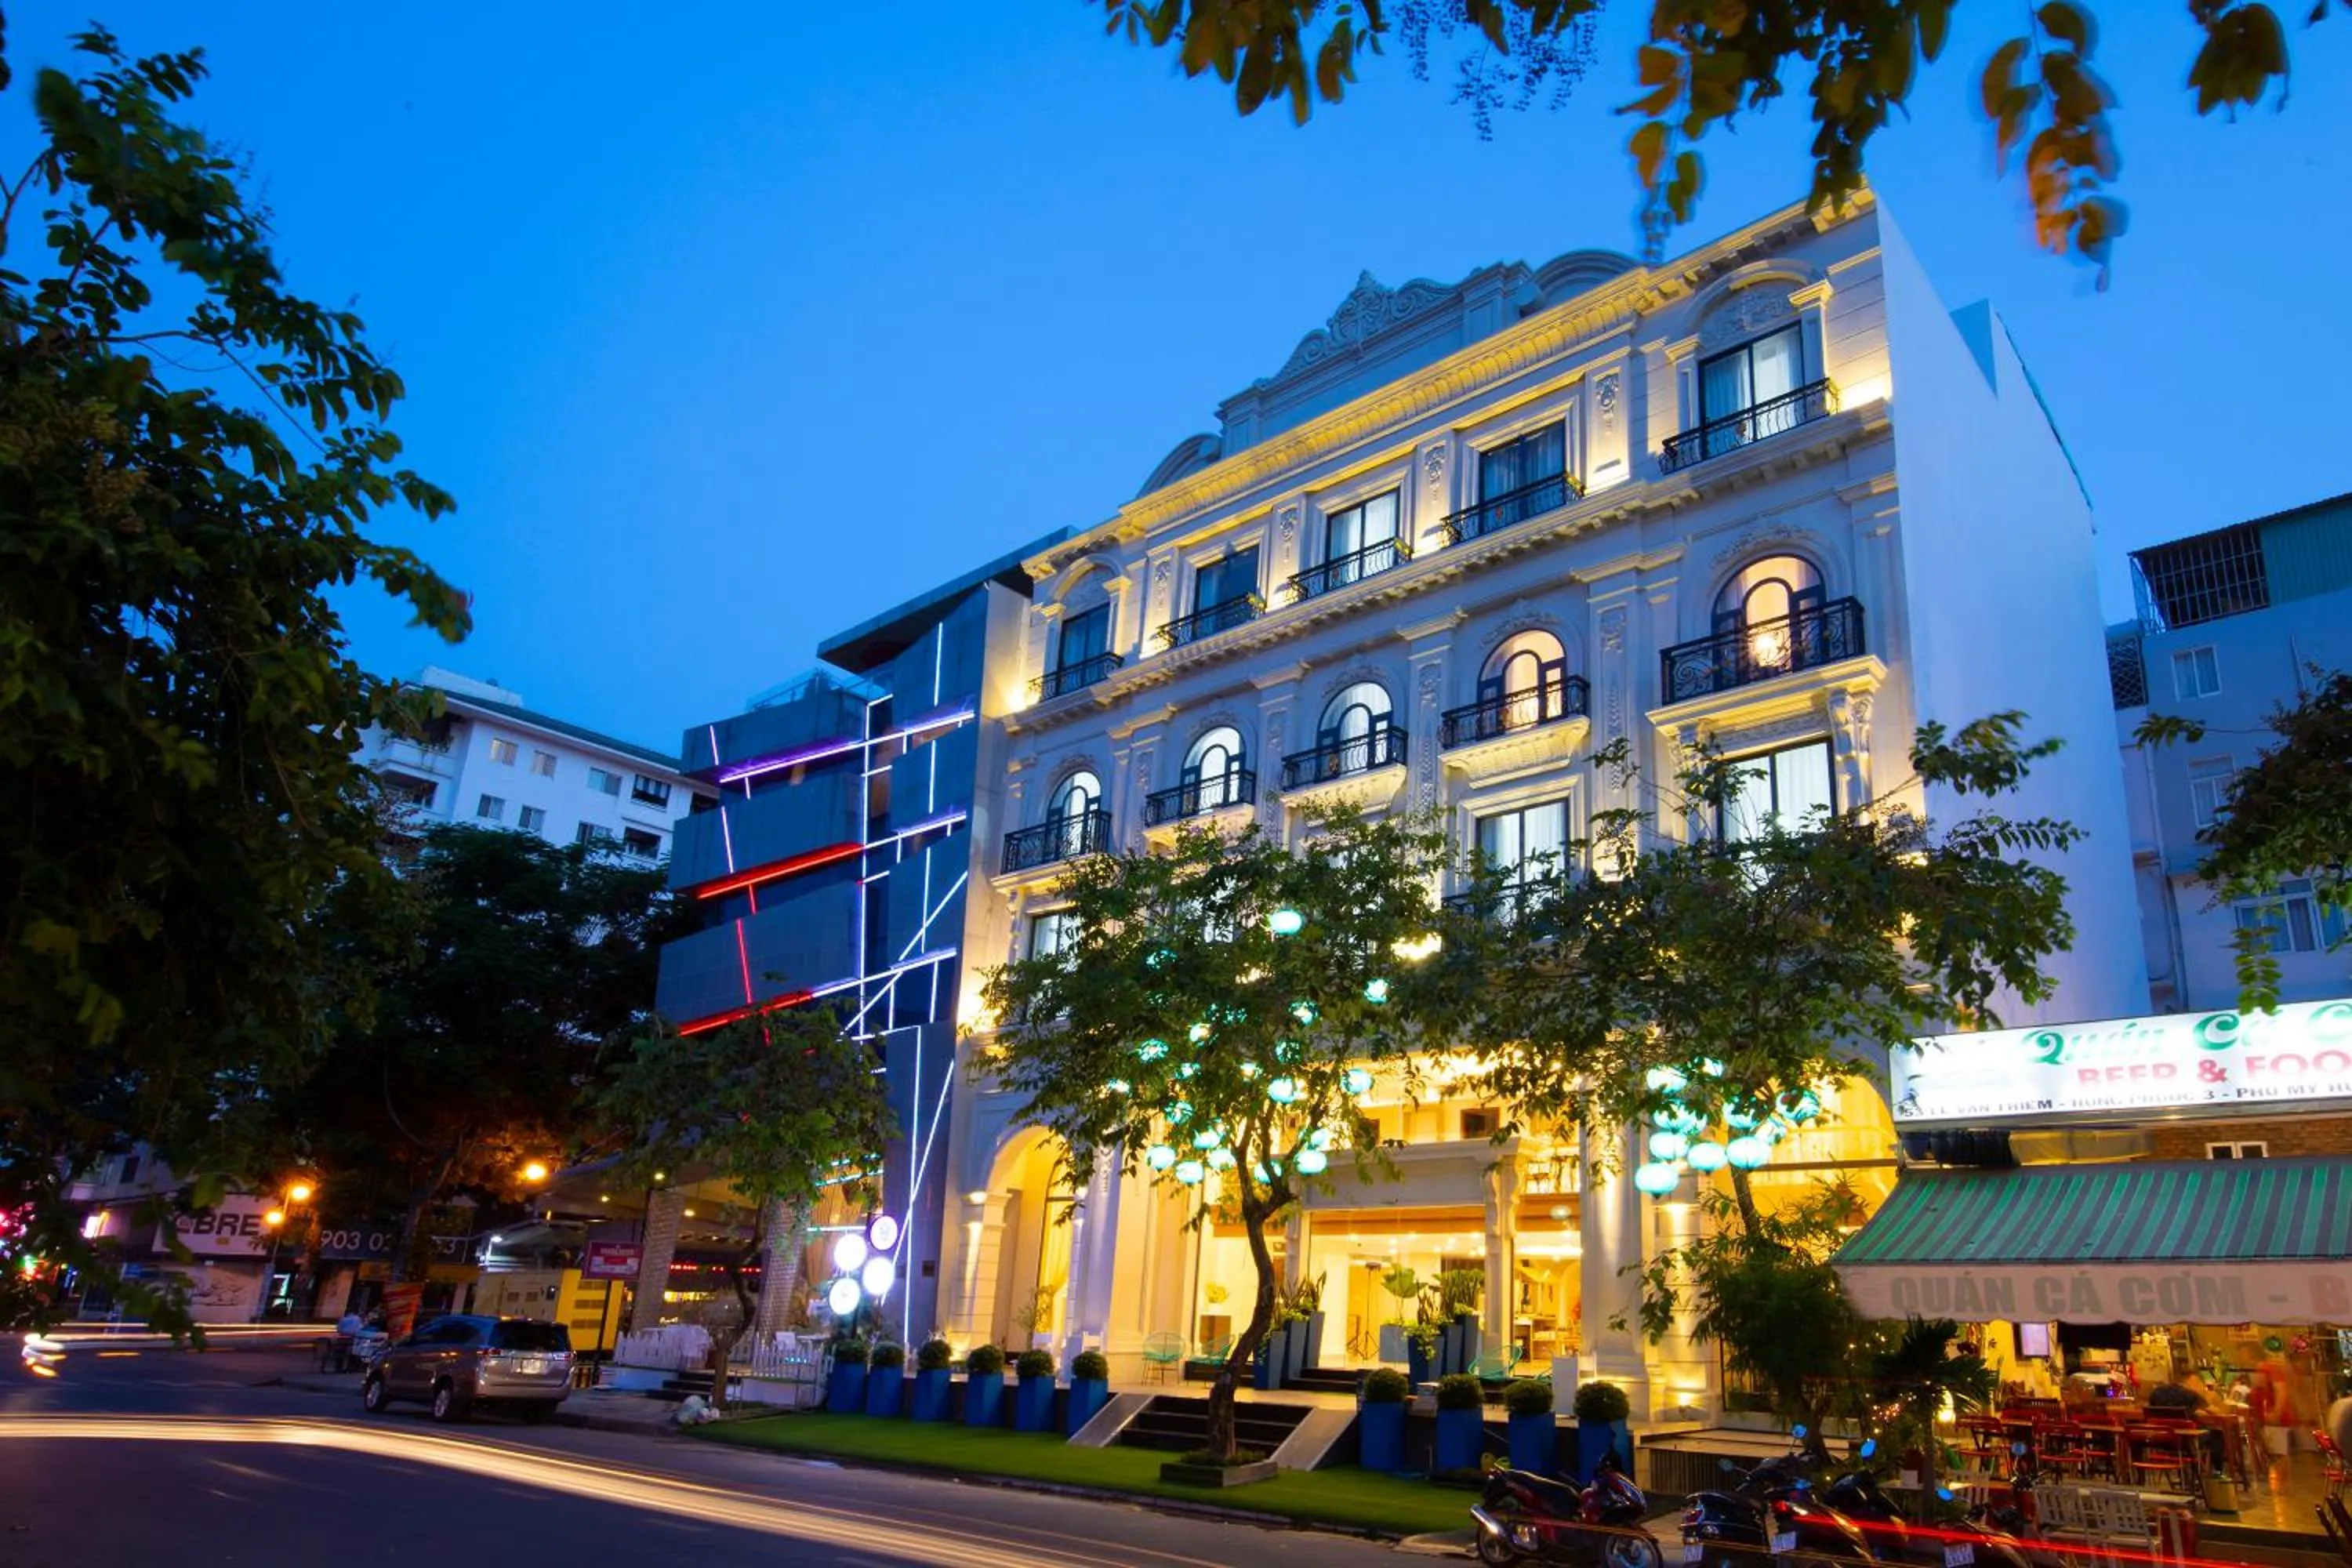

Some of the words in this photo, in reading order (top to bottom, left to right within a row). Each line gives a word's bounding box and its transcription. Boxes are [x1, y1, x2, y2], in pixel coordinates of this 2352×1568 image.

[2197, 1058, 2229, 1084] &
[1890, 1269, 2016, 1315] QUÁN
[2033, 1269, 2104, 1316] CÁ
